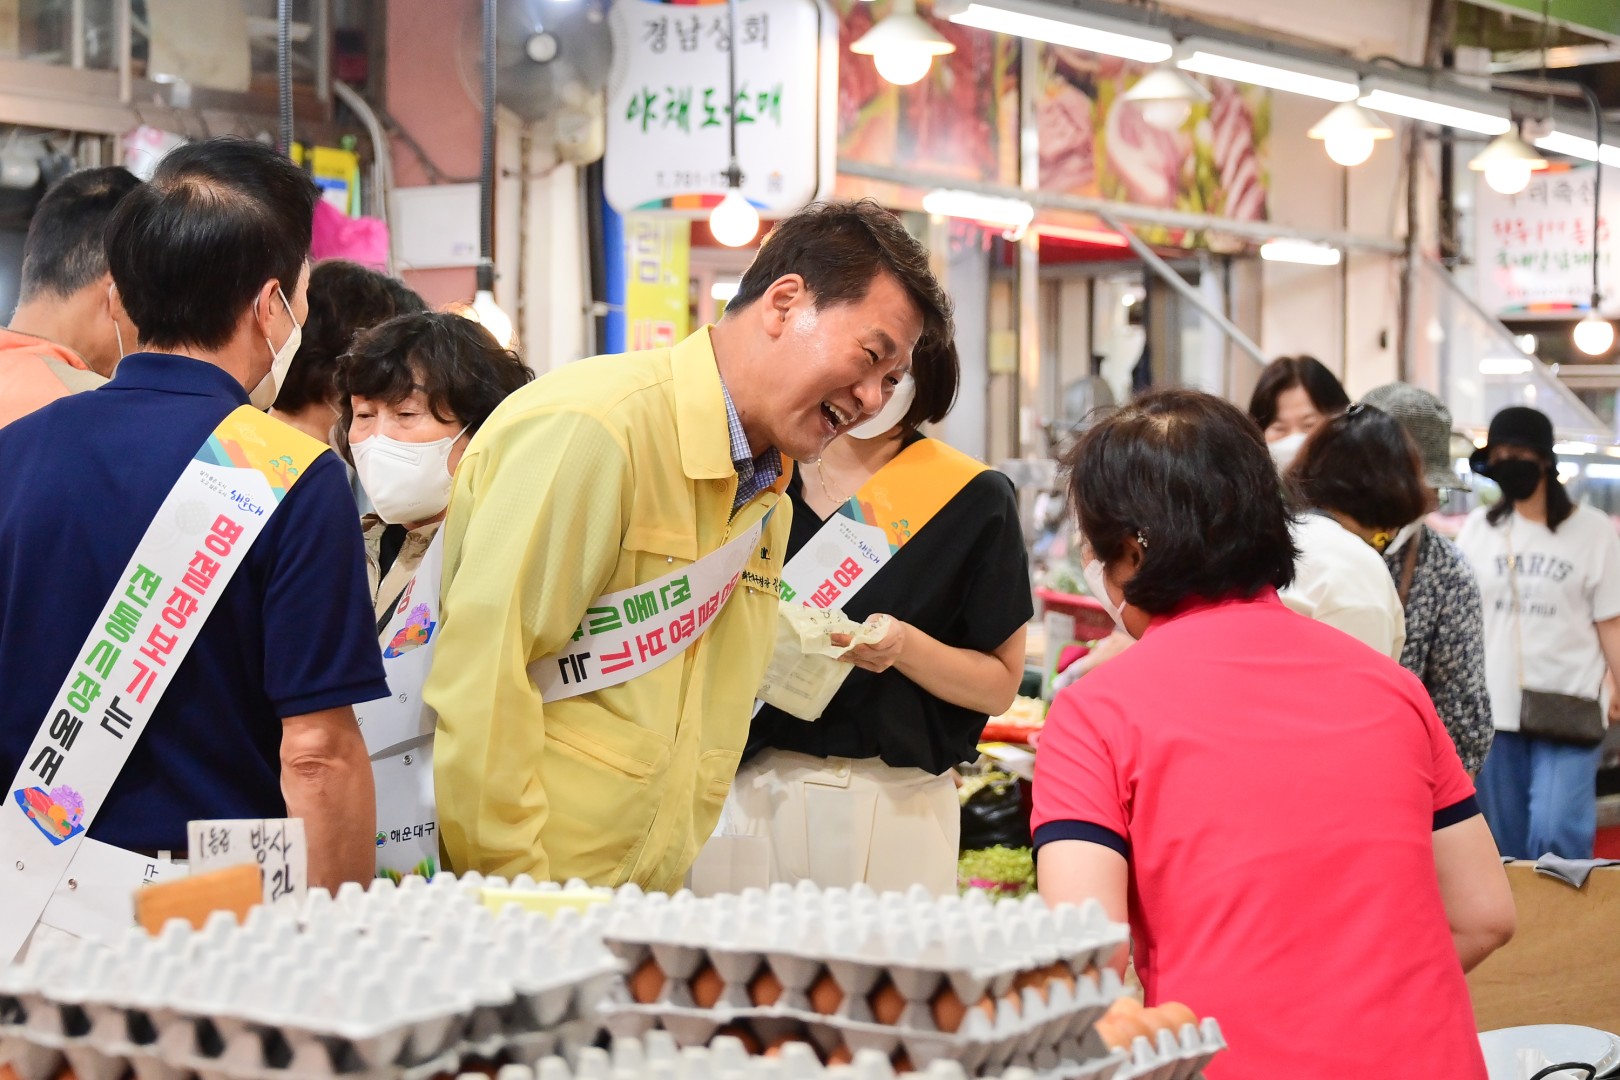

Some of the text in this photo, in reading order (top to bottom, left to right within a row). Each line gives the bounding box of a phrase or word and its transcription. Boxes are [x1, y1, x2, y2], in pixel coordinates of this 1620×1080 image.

[641, 13, 769, 53] 경남상회
[1495, 553, 1574, 582] PARIS
[250, 820, 292, 864] 방사
[390, 821, 435, 842] 해운대구
